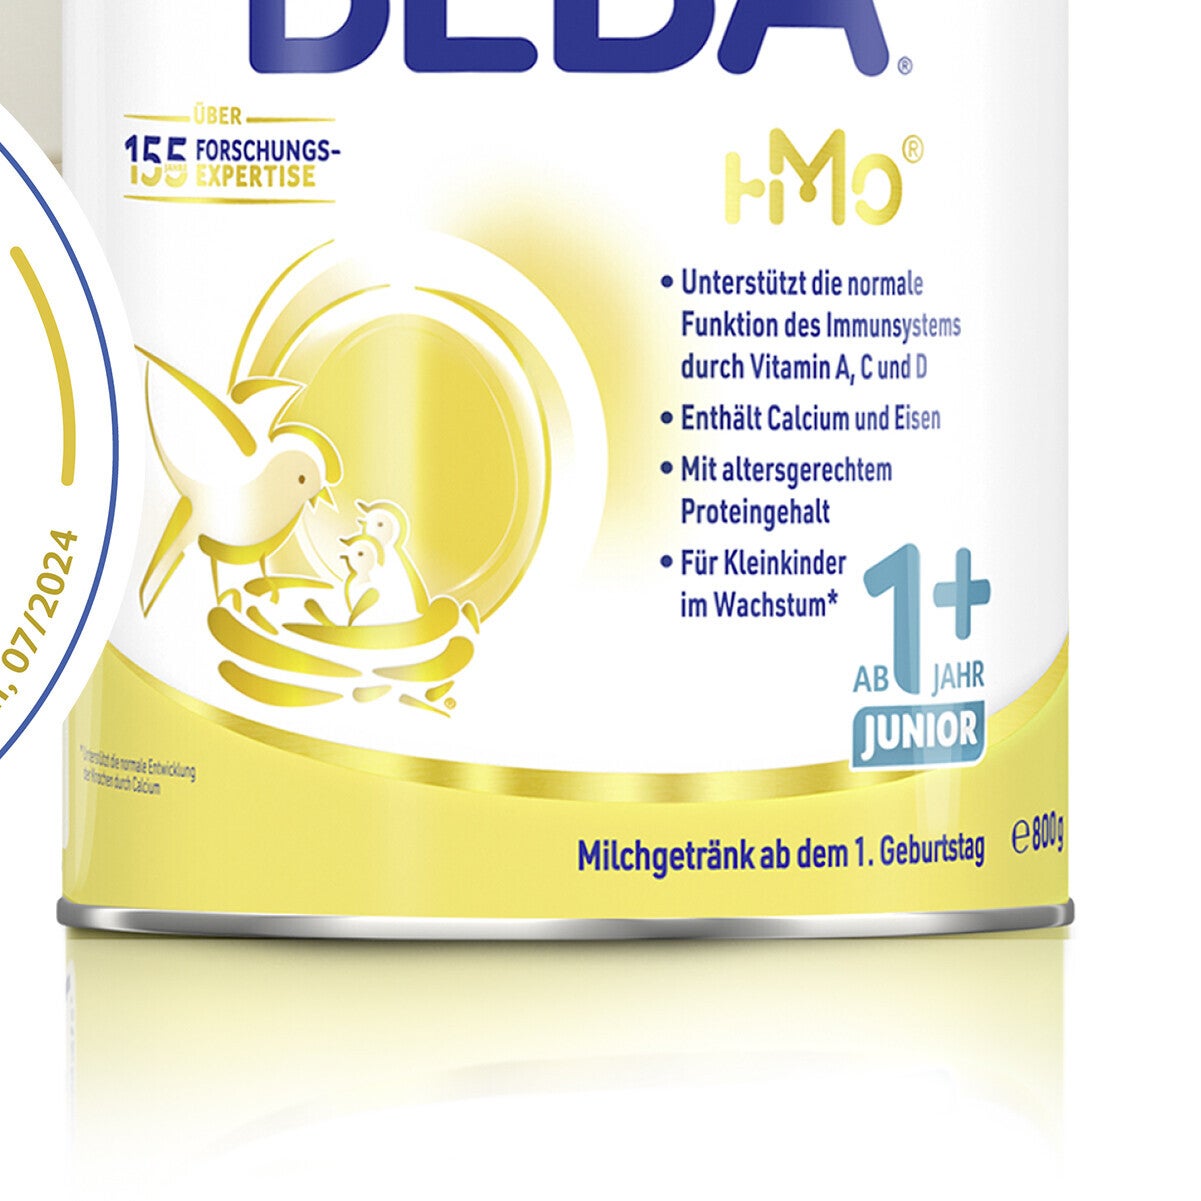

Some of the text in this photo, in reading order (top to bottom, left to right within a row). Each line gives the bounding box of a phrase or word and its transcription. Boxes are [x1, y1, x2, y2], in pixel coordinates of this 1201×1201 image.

[193, 102, 242, 125] ÜBER
[125, 134, 341, 188] 155 FORSCHUNGS-
[196, 164, 316, 188] EXPERTISE
[680, 266, 925, 297] Unterstützt die normale
[680, 308, 963, 345] Funktion des Immunsystems
[680, 351, 929, 386] durch Vitamin A, C und D
[680, 403, 943, 432] Enthält Calcium und Eisen
[680, 454, 894, 490] Mit altersgerechtem
[680, 497, 831, 532] Proteingehalt
[680, 548, 847, 577] Für Kleinkinder
[680, 590, 709, 619] im
[862, 542, 992, 696] 1+
[852, 660, 985, 698] AB JAHR
[860, 709, 978, 762] JUNIOR
[577, 831, 986, 881] Milchgetränk ab dem 1. Geburtstag
